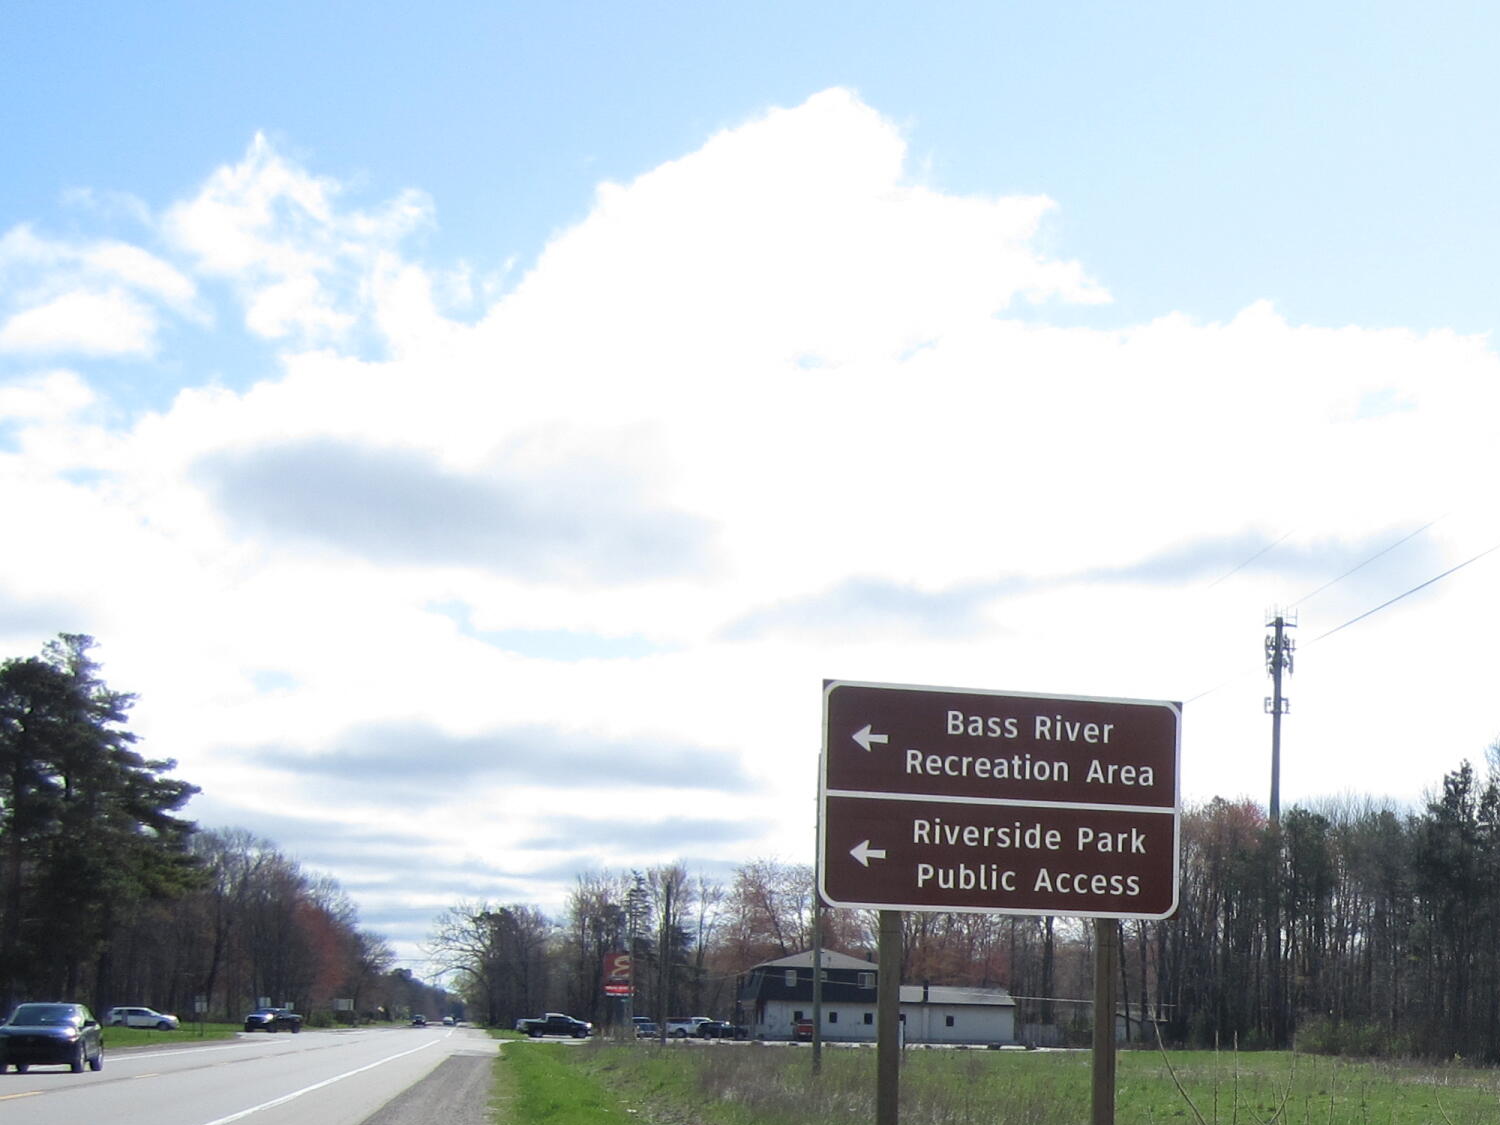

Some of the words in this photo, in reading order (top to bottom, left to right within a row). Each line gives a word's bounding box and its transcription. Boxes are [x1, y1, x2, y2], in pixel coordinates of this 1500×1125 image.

[947, 710, 1018, 739] Bass
[1035, 714, 1114, 744] River
[906, 749, 1069, 782] Recreation
[1086, 759, 1154, 786] Area
[913, 817, 1061, 850] Riverside
[1078, 827, 1146, 854] Park
[917, 863, 1016, 891] Public
[1034, 868, 1140, 896] Access
